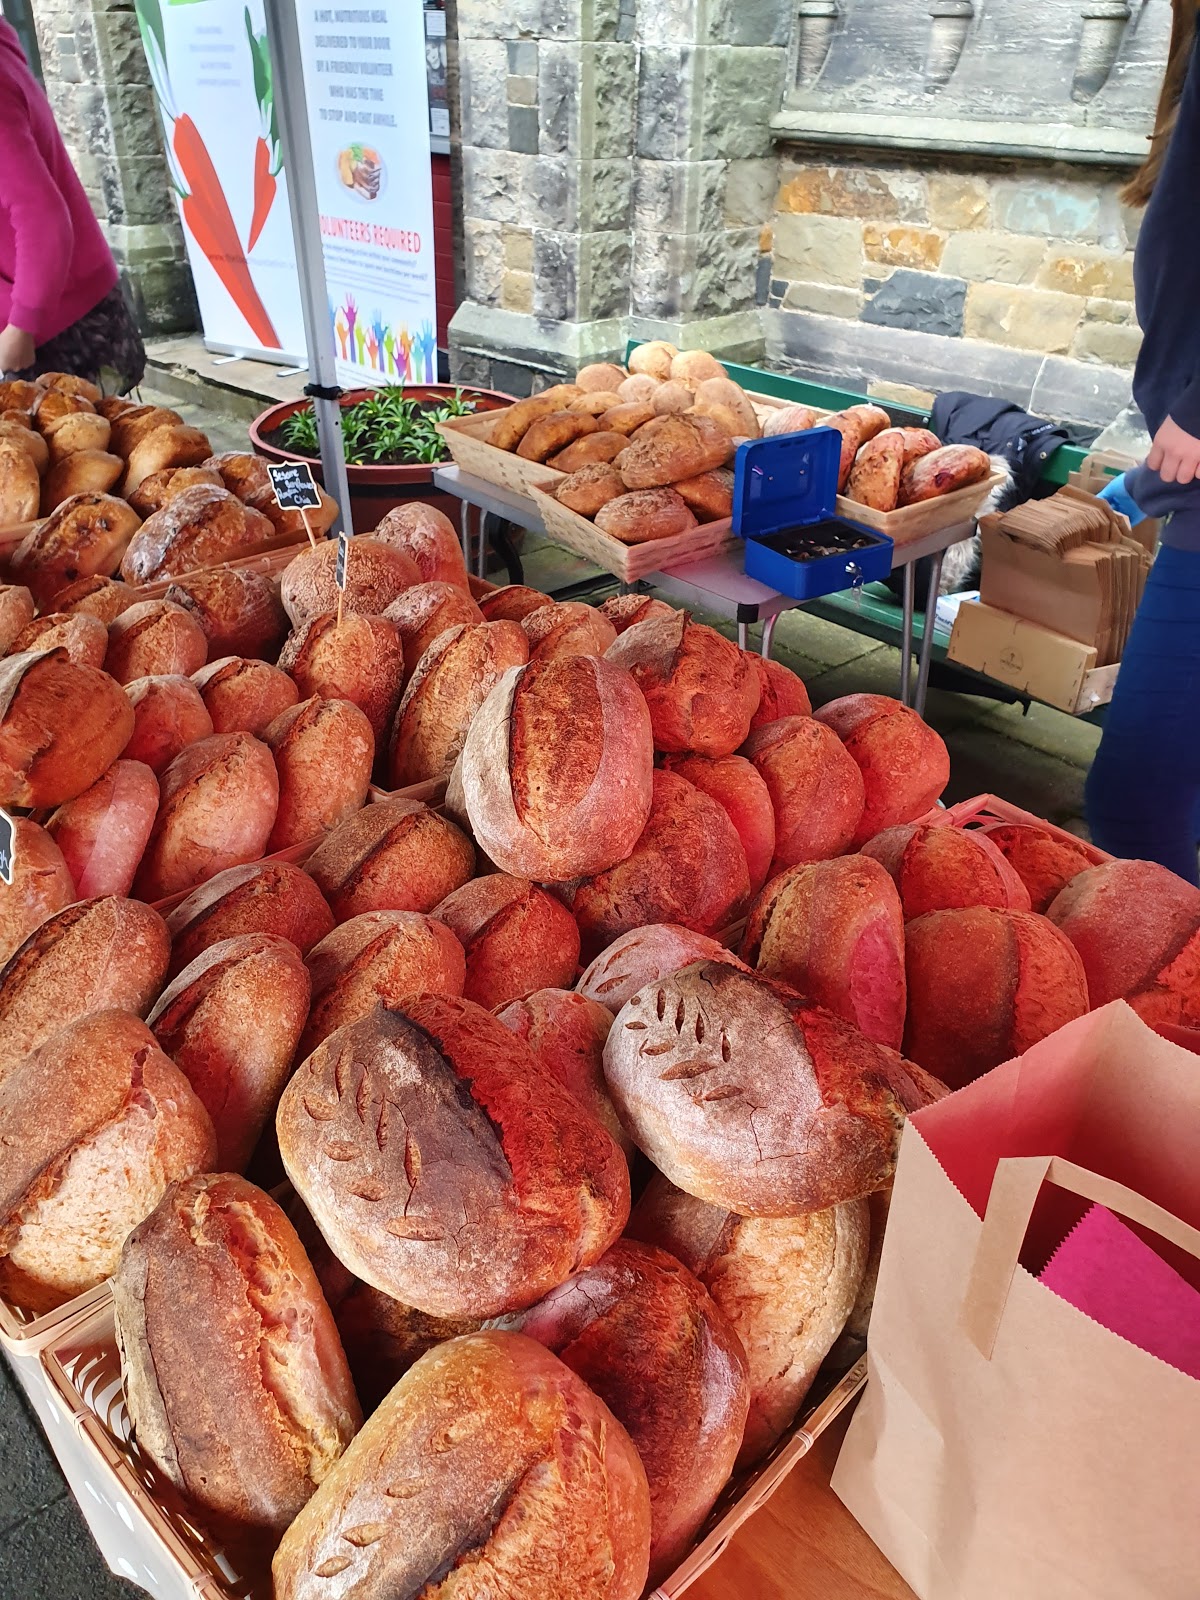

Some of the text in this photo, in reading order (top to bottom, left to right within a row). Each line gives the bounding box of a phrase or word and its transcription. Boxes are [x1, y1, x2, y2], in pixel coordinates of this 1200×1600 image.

[371, 10, 388, 23] MEAL
[315, 35, 391, 50] DELIVERED TO YOUR DOOR
[316, 60, 324, 72] BY
[330, 61, 359, 74] FRIENDLY
[360, 62, 393, 76] VOLUNTEER
[329, 85, 384, 101] WHO HAS THE TIME
[319, 108, 328, 120] TO
[328, 109, 343, 122] STOP
[344, 110, 357, 123] AND
[358, 111, 372, 124] CHAT
[373, 224, 421, 254] REQUIRED
